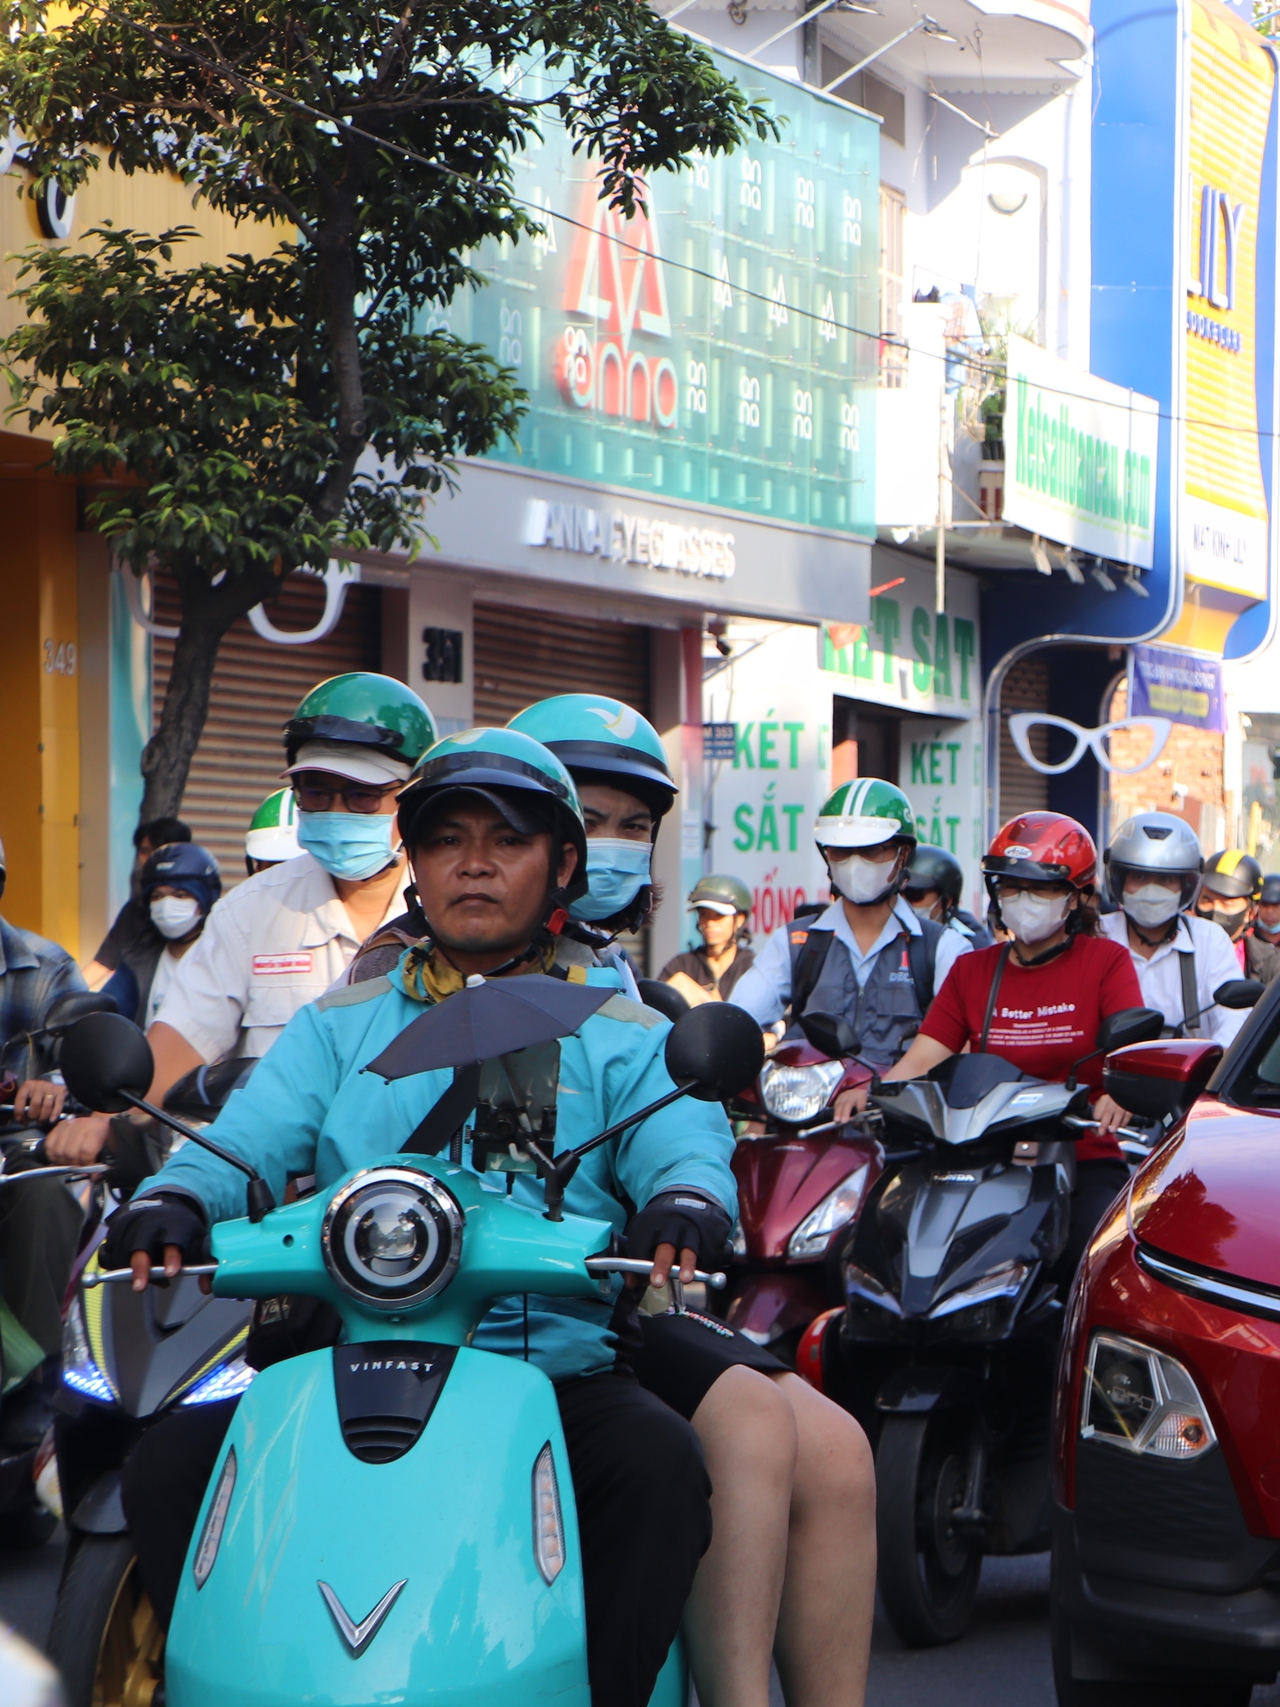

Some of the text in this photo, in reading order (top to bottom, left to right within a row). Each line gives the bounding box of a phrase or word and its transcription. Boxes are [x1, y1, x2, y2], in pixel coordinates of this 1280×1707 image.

[527, 499, 611, 559] ANNA
[44, 638, 77, 677] 349
[422, 626, 464, 684] 351
[732, 708, 805, 769] KÉT
[911, 730, 961, 785] KÉT
[733, 781, 804, 853] SẮT
[1001, 1007, 1034, 1020] Better
[1037, 1002, 1076, 1018] Mistake
[350, 1361, 434, 1373] VINFAST
